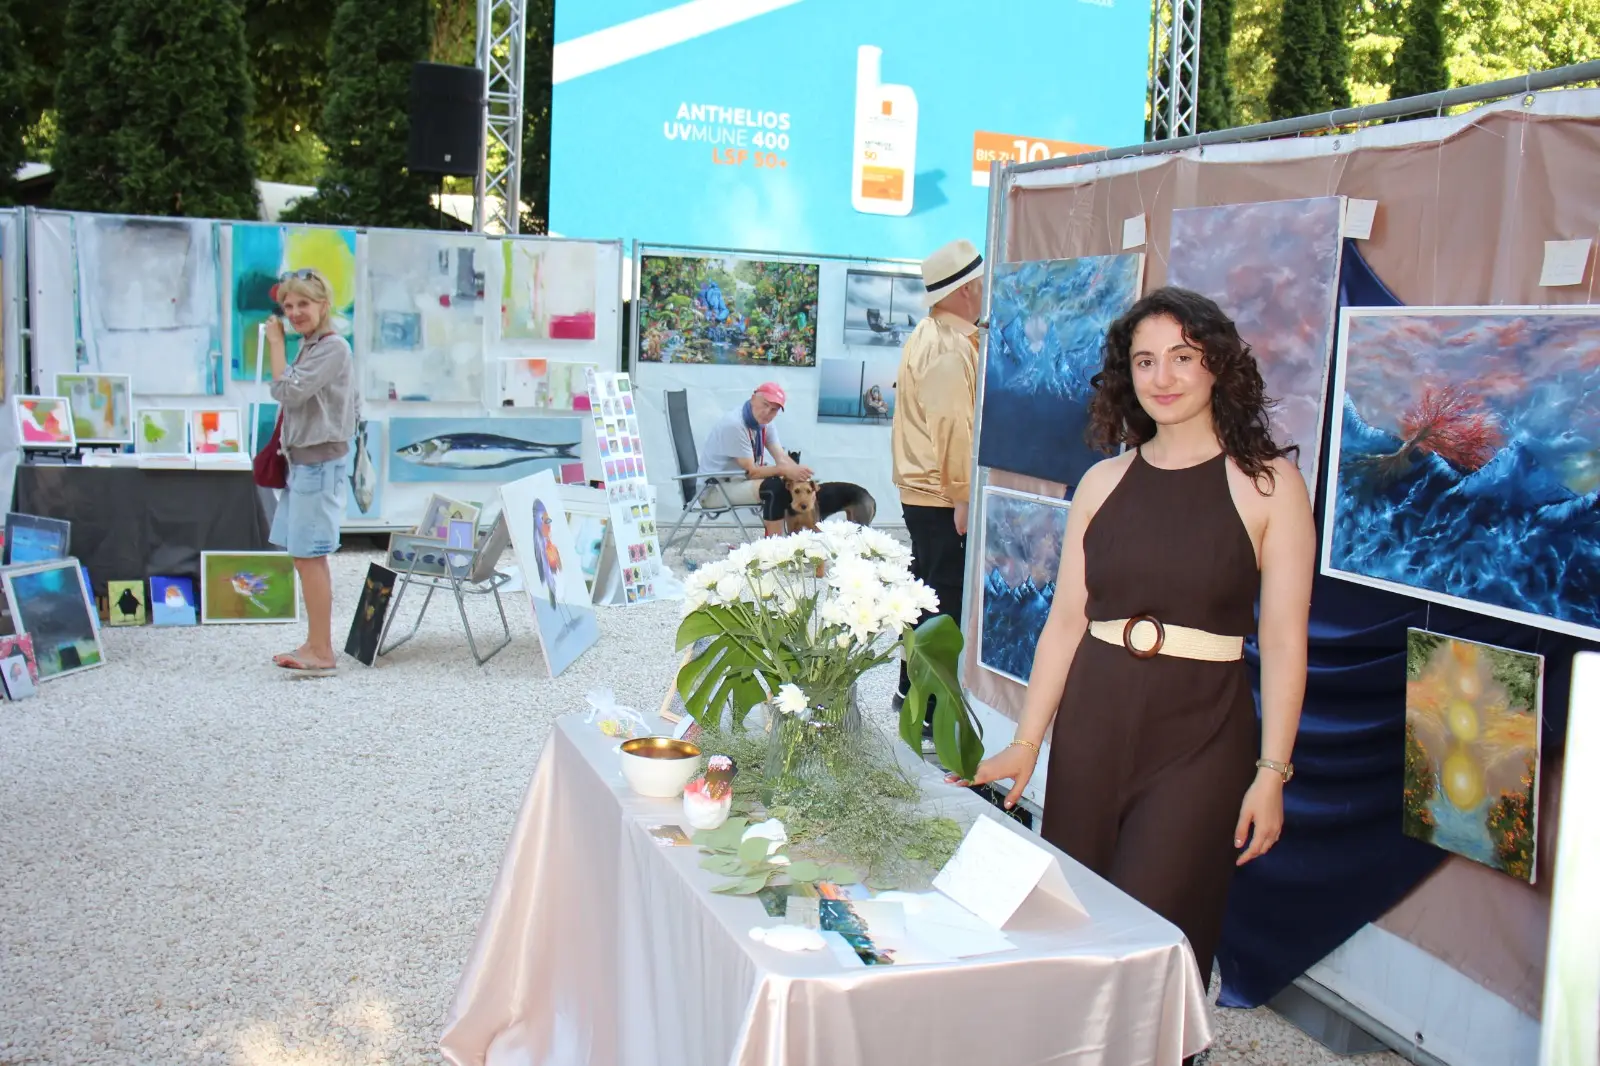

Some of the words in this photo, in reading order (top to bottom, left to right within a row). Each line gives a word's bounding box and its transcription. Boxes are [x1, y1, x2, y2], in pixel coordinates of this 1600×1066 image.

[677, 102, 790, 130] ANTHELIOS
[663, 121, 748, 147] UVMUNE
[751, 131, 790, 151] 400
[712, 147, 748, 165] LSF
[754, 151, 788, 169] 50+
[976, 148, 995, 162] BIS
